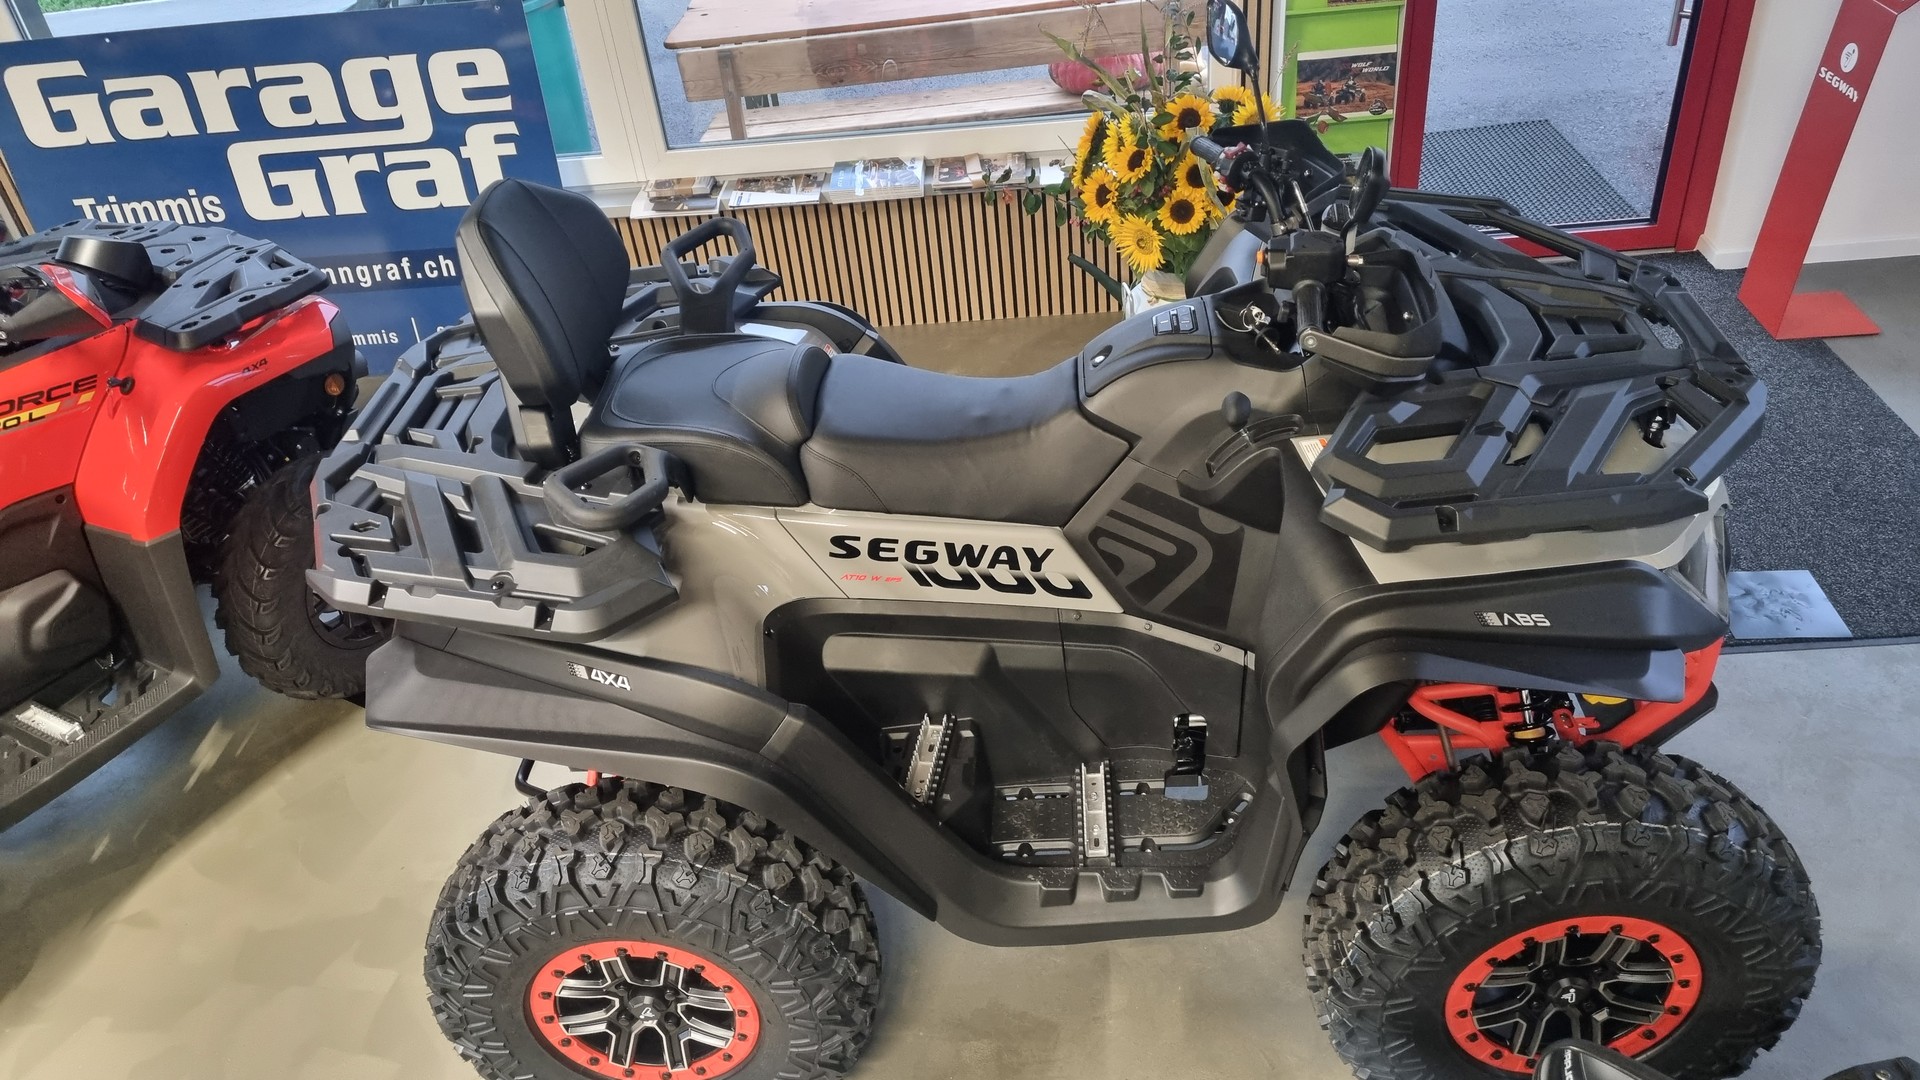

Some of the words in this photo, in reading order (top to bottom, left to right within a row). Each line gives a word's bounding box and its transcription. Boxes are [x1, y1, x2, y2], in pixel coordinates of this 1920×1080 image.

[1361, 65, 1390, 73] WORLD
[1818, 66, 1859, 103] SEGWAY
[3, 48, 513, 149] Garage
[226, 121, 522, 221] Graf
[72, 188, 226, 223] Trimmis
[828, 535, 1055, 573] SEGWAY
[1503, 612, 1551, 627] ABS
